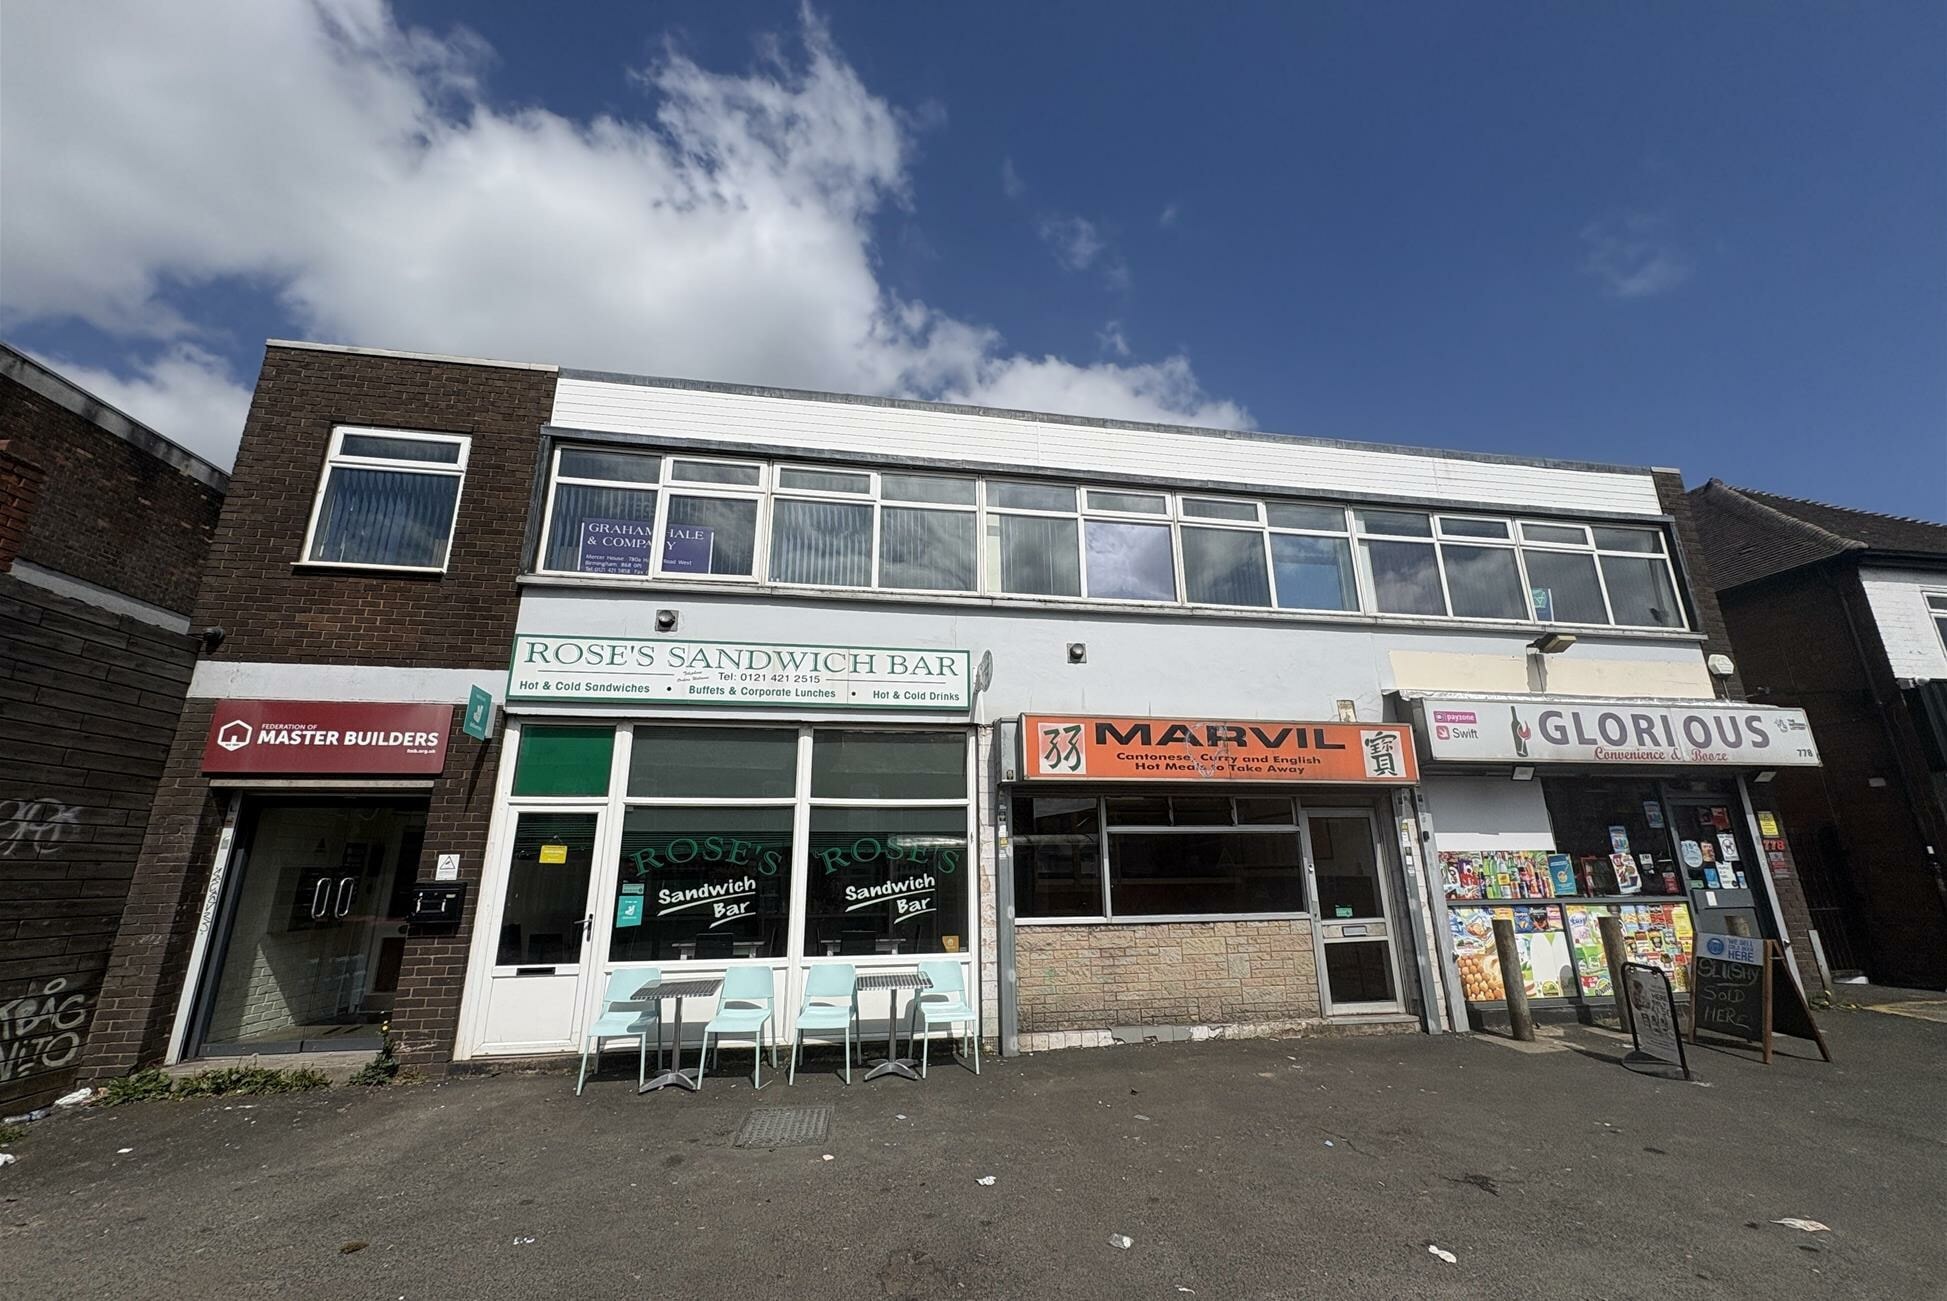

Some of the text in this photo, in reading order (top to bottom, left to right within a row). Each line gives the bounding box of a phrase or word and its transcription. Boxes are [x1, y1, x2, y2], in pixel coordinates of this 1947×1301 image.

[588, 522, 704, 540] GRAHAM HALE
[587, 536, 676, 550] & COMPAY
[524, 641, 959, 676] ROSE'S SANDWICH BAR
[718, 672, 820, 684] Tel: 0121 421 2515
[520, 680, 650, 694] Hot & Cold Sandwiches
[688, 684, 836, 698] Buffets & Corporate Lunches
[873, 690, 960, 701] Hot & Cold Drinks
[1446, 714, 1474, 722] payzone
[1094, 722, 1346, 750] MARVIL
[1452, 728, 1479, 740] Swift
[1538, 710, 1770, 749] GLORIOUS
[257, 730, 439, 747] MASTER BUILDERS
[1200, 754, 1238, 764] Curry
[1242, 755, 1268, 763] and
[1273, 756, 1321, 766] English
[1594, 746, 1665, 760] Convenience
[1692, 748, 1728, 762] Booze
[1796, 748, 1814, 758] 778
[1135, 762, 1160, 770] Hot
[1228, 764, 1262, 773] Take
[1267, 766, 1304, 774] Away
[1762, 838, 1786, 850] 778
[630, 835, 783, 878] ROSE'S
[815, 835, 960, 876] ROSE'S
[658, 876, 756, 905] Sandwich
[845, 873, 936, 902] Sandwich
[713, 901, 750, 918] Bar
[896, 898, 931, 914] Bar
[1728, 950, 1754, 962] HERE
